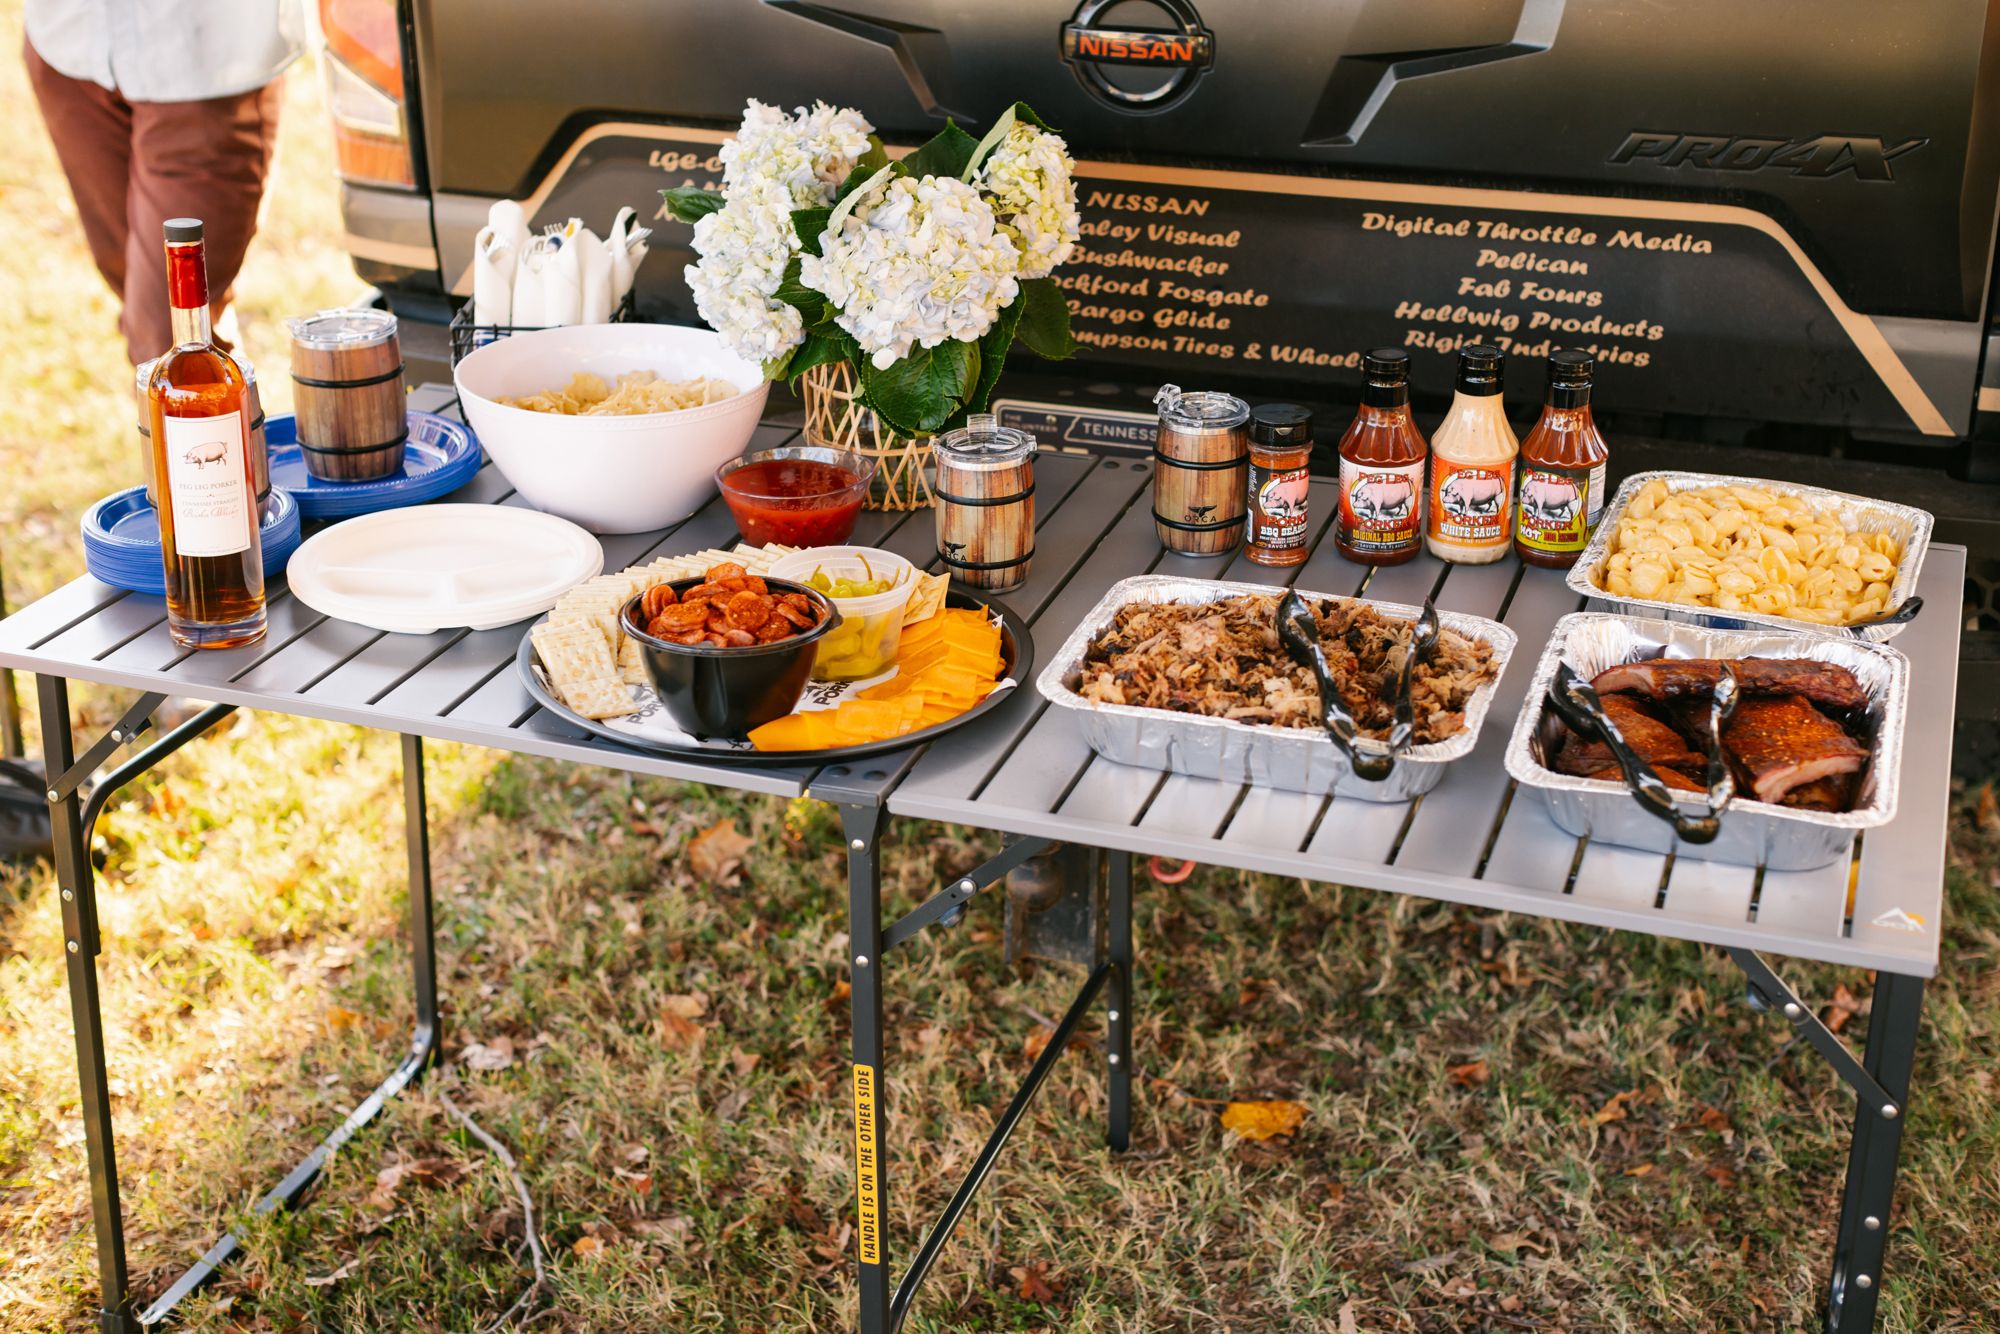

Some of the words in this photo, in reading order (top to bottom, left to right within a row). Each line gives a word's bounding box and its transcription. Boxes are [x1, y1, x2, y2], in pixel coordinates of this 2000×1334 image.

[1079, 36, 1192, 61] NISSAN
[1086, 191, 1210, 216] NISSAN
[1078, 219, 1142, 243] aley
[1147, 223, 1242, 248] Visual
[1361, 212, 1471, 238] Digital
[1476, 220, 1598, 246] Throttle
[1606, 230, 1713, 254] Media
[1065, 244, 1230, 277] Bushwacker
[1476, 249, 1589, 275] Pelican
[1050, 273, 1150, 296] ckford
[1157, 280, 1270, 307] Fosgate
[1457, 277, 1511, 298] Fab
[1519, 281, 1603, 308] Fours
[1065, 299, 1146, 325] Cargo
[1153, 308, 1231, 330] Glide
[1394, 301, 1521, 332] Hellwig
[1529, 311, 1665, 341] Products
[1069, 330, 1168, 350] mpson
[1173, 335, 1236, 359] Tires
[1243, 343, 1263, 360] &
[1494, 336, 1651, 367] Indries
[1082, 422, 1158, 441] TENNESS
[1270, 471, 1297, 483] PEG
[1359, 472, 1383, 484] PEG
[1386, 473, 1409, 484] LEG
[1449, 466, 1473, 479] PEG
[1526, 468, 1547, 483] PEG
[1548, 474, 1573, 485] LEG
[1184, 515, 1217, 523] ORCA
[1266, 512, 1308, 527] PORK
[1354, 515, 1409, 529] PORKER
[1444, 510, 1500, 526] PORKER
[1522, 511, 1573, 530] PORKER
[1261, 526, 1278, 538] BBQ
[1440, 523, 1470, 537] WHITE
[1473, 525, 1501, 537] SAUCE
[1521, 525, 1541, 540] HOT
[858, 1070, 870, 1098] SIDE
[859, 1103, 872, 1141] OTHER
[861, 1148, 873, 1169] THE
[862, 1174, 873, 1191] ON
[863, 1196, 874, 1208] IS
[863, 1212, 876, 1259] HANDLE
